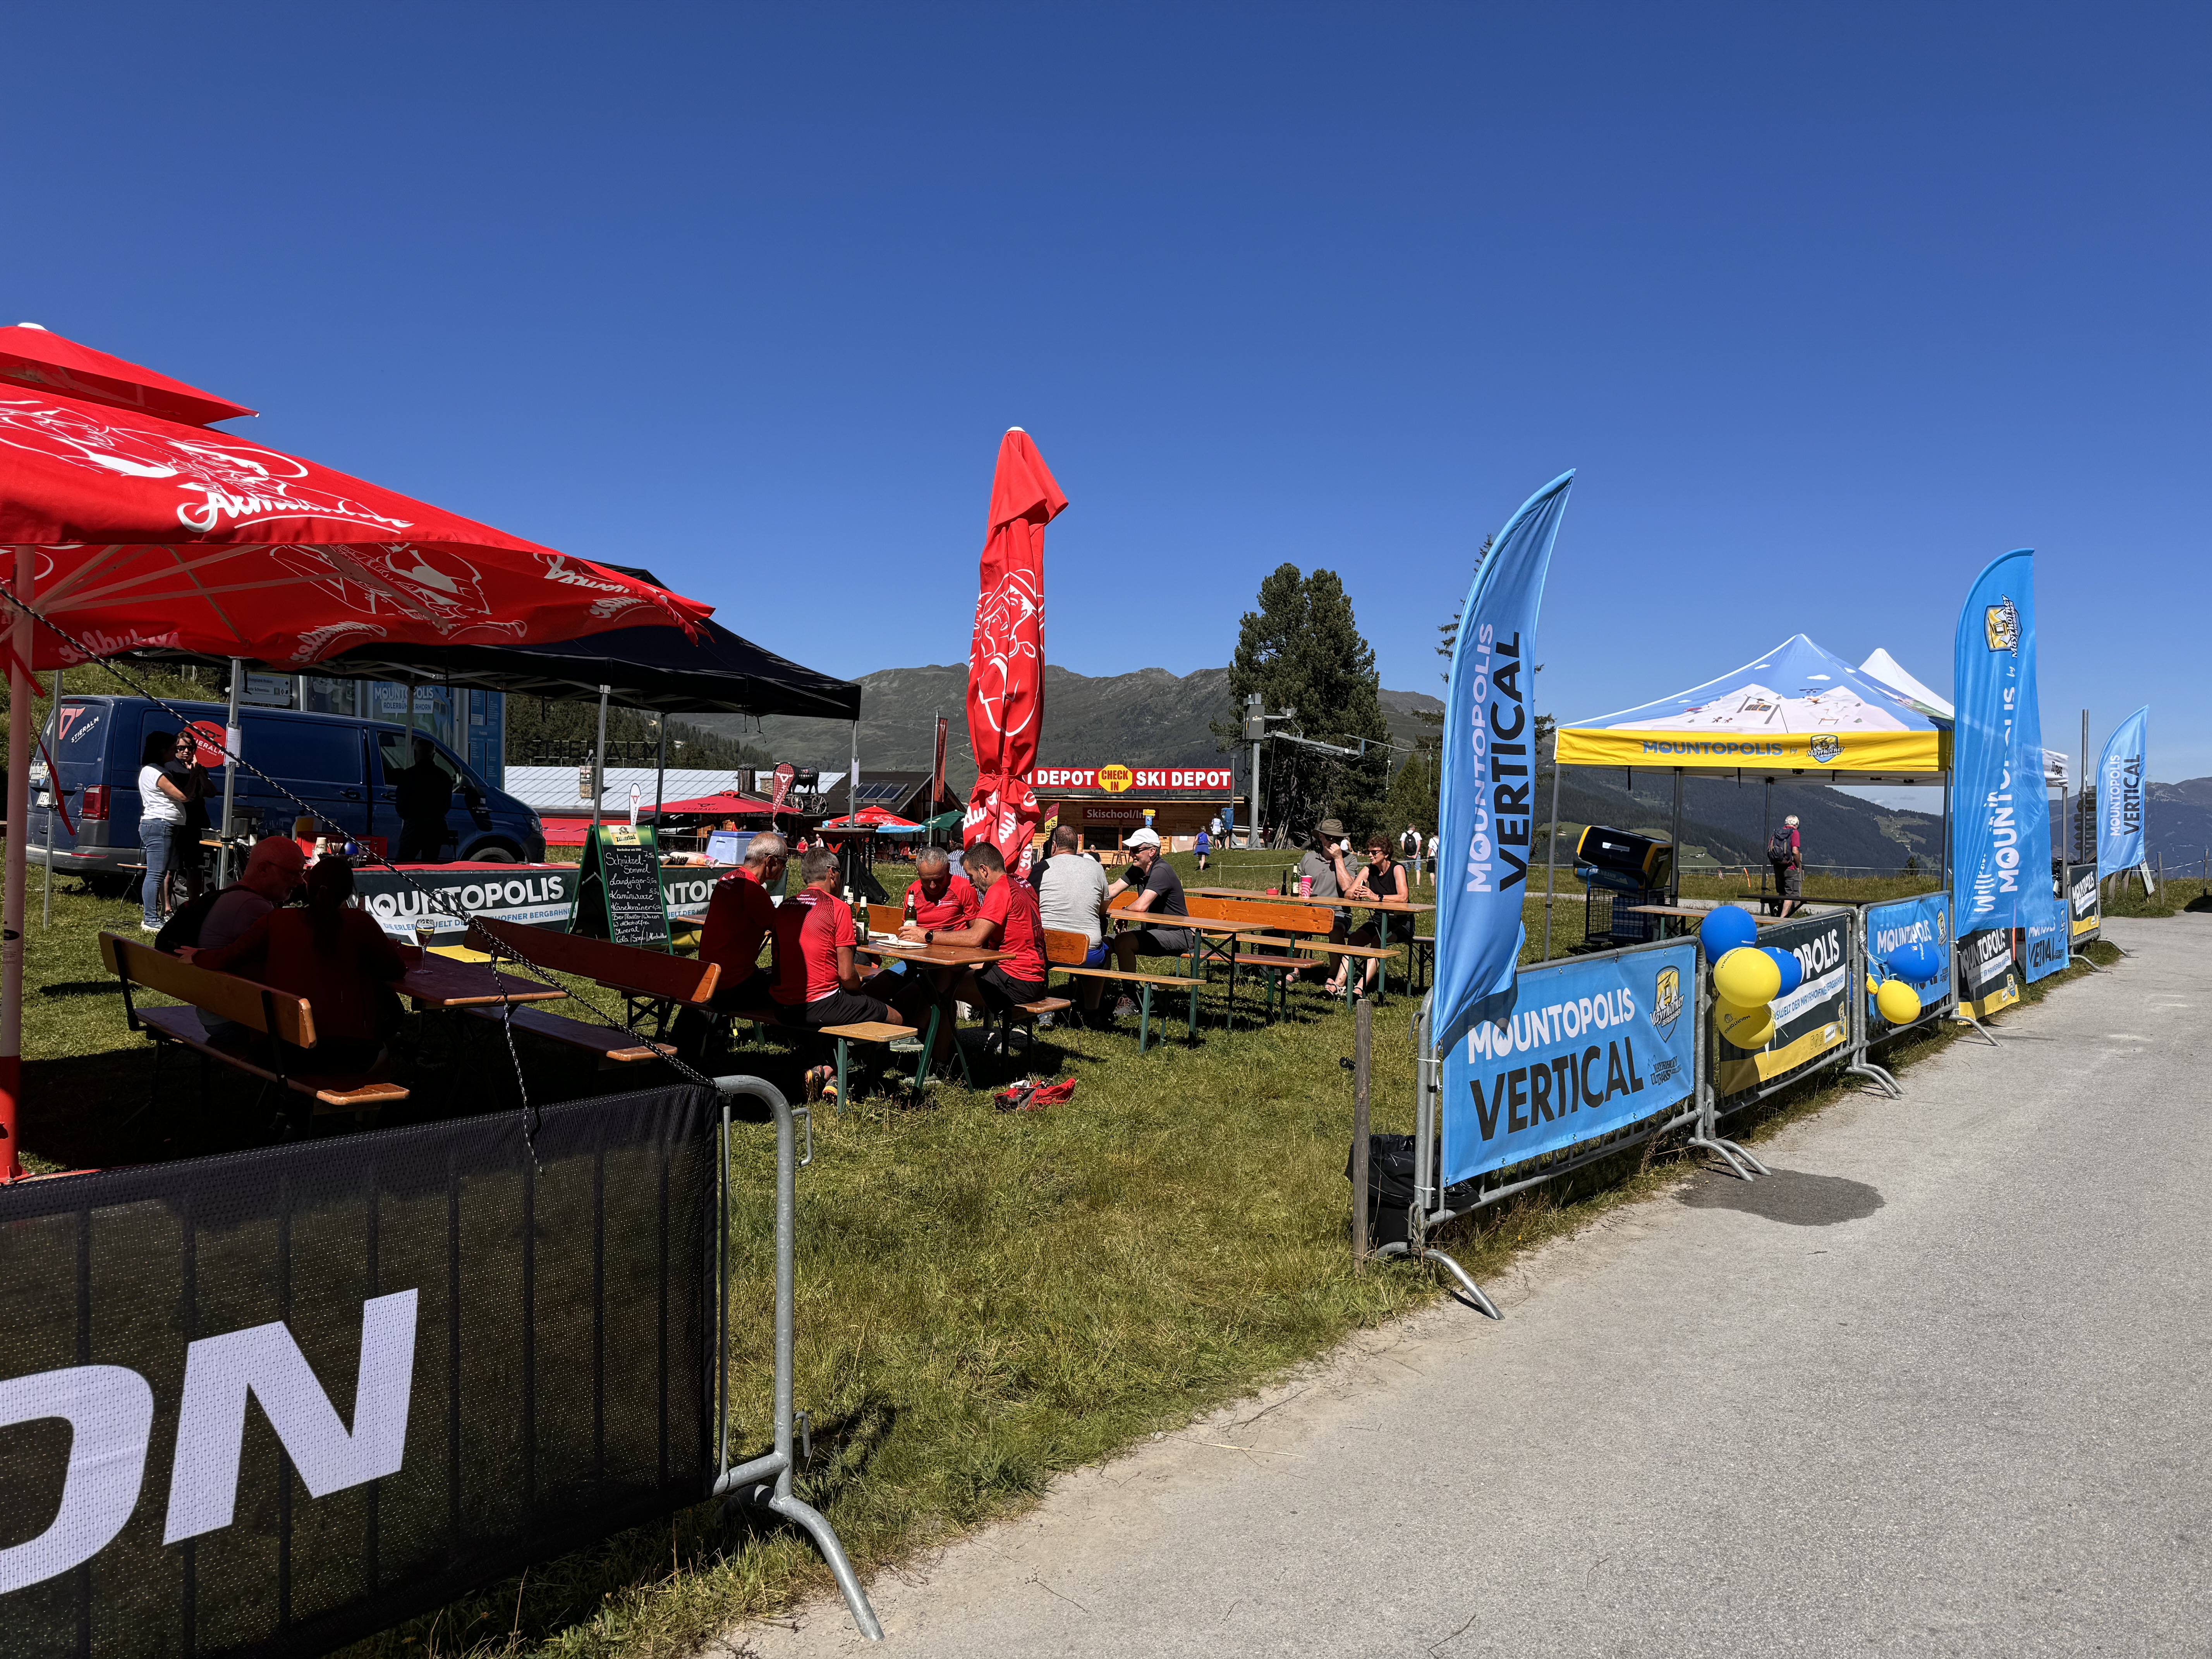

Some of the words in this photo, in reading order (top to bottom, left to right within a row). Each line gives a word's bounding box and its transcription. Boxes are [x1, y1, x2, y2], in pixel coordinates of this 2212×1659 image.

[2006, 666, 2015, 677] by
[375, 687, 434, 700] MOUNTOLIS
[383, 700, 414, 710] ADLERBÜH
[415, 702, 431, 710] AHORN
[71, 716, 99, 743] STIERALM
[194, 737, 225, 756] IERALM
[1643, 741, 1783, 756] MOUNTOPOLIS
[1790, 746, 1798, 755] by
[1466, 623, 1493, 893] MOUNTOPOLIS
[1490, 632, 1530, 891] VERTICAL
[1037, 770, 1095, 786] DEPOT
[1101, 770, 1128, 780] CHECK
[1135, 771, 1166, 787] SKI
[1171, 771, 1231, 787] DEPOT
[1111, 781, 1119, 791] IN
[2110, 754, 2121, 836] MOUNTOPOLIS
[2123, 754, 2140, 835] VERTICAL
[1087, 809, 1144, 819] Skischool/In
[623, 864, 651, 874] Semmel
[1468, 987, 1635, 1064] MOUNTOPOLIS
[1469, 1036, 1644, 1142] VERTICAL
